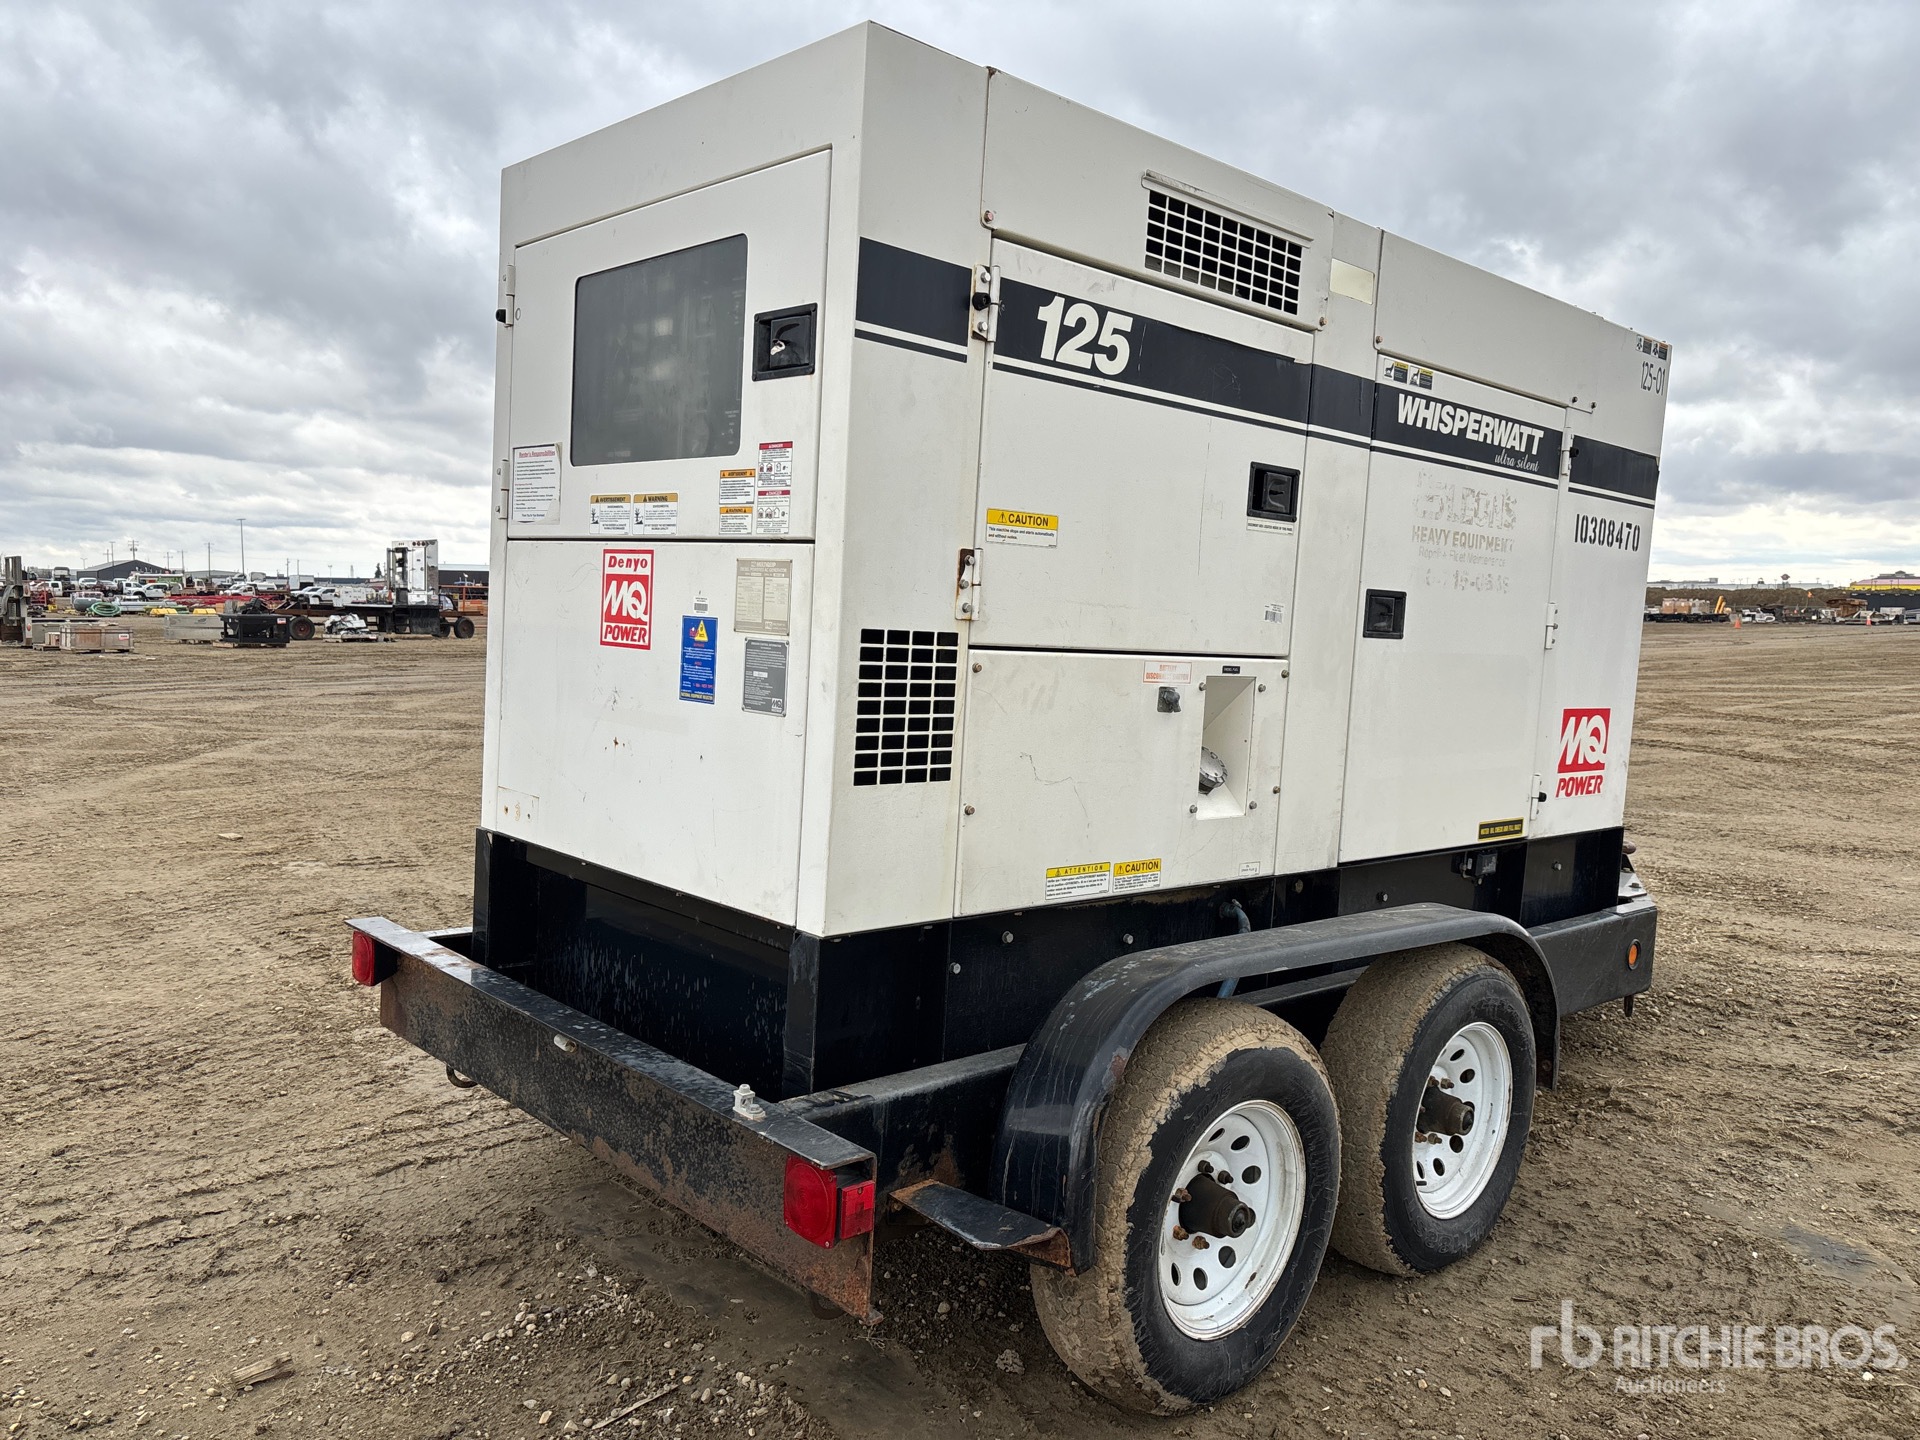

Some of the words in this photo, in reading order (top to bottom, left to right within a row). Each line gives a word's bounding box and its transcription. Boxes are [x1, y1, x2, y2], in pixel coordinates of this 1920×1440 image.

[1037, 295, 1133, 376] 125
[1641, 361, 1665, 396] 125-01
[1397, 393, 1544, 455] WHISPERWATT
[1494, 449, 1516, 467] ultra
[1516, 453, 1540, 472] silent
[1008, 513, 1049, 527] CAUTION
[1411, 525, 1451, 546] HEAVY
[608, 555, 648, 572] Denyo
[604, 580, 649, 622] MQ
[604, 624, 648, 644] POWER
[1559, 714, 1607, 766] MQ
[1555, 774, 1603, 798] POWER
[1064, 865, 1103, 875] ATTENTION
[1124, 860, 1159, 873] CAUTION
